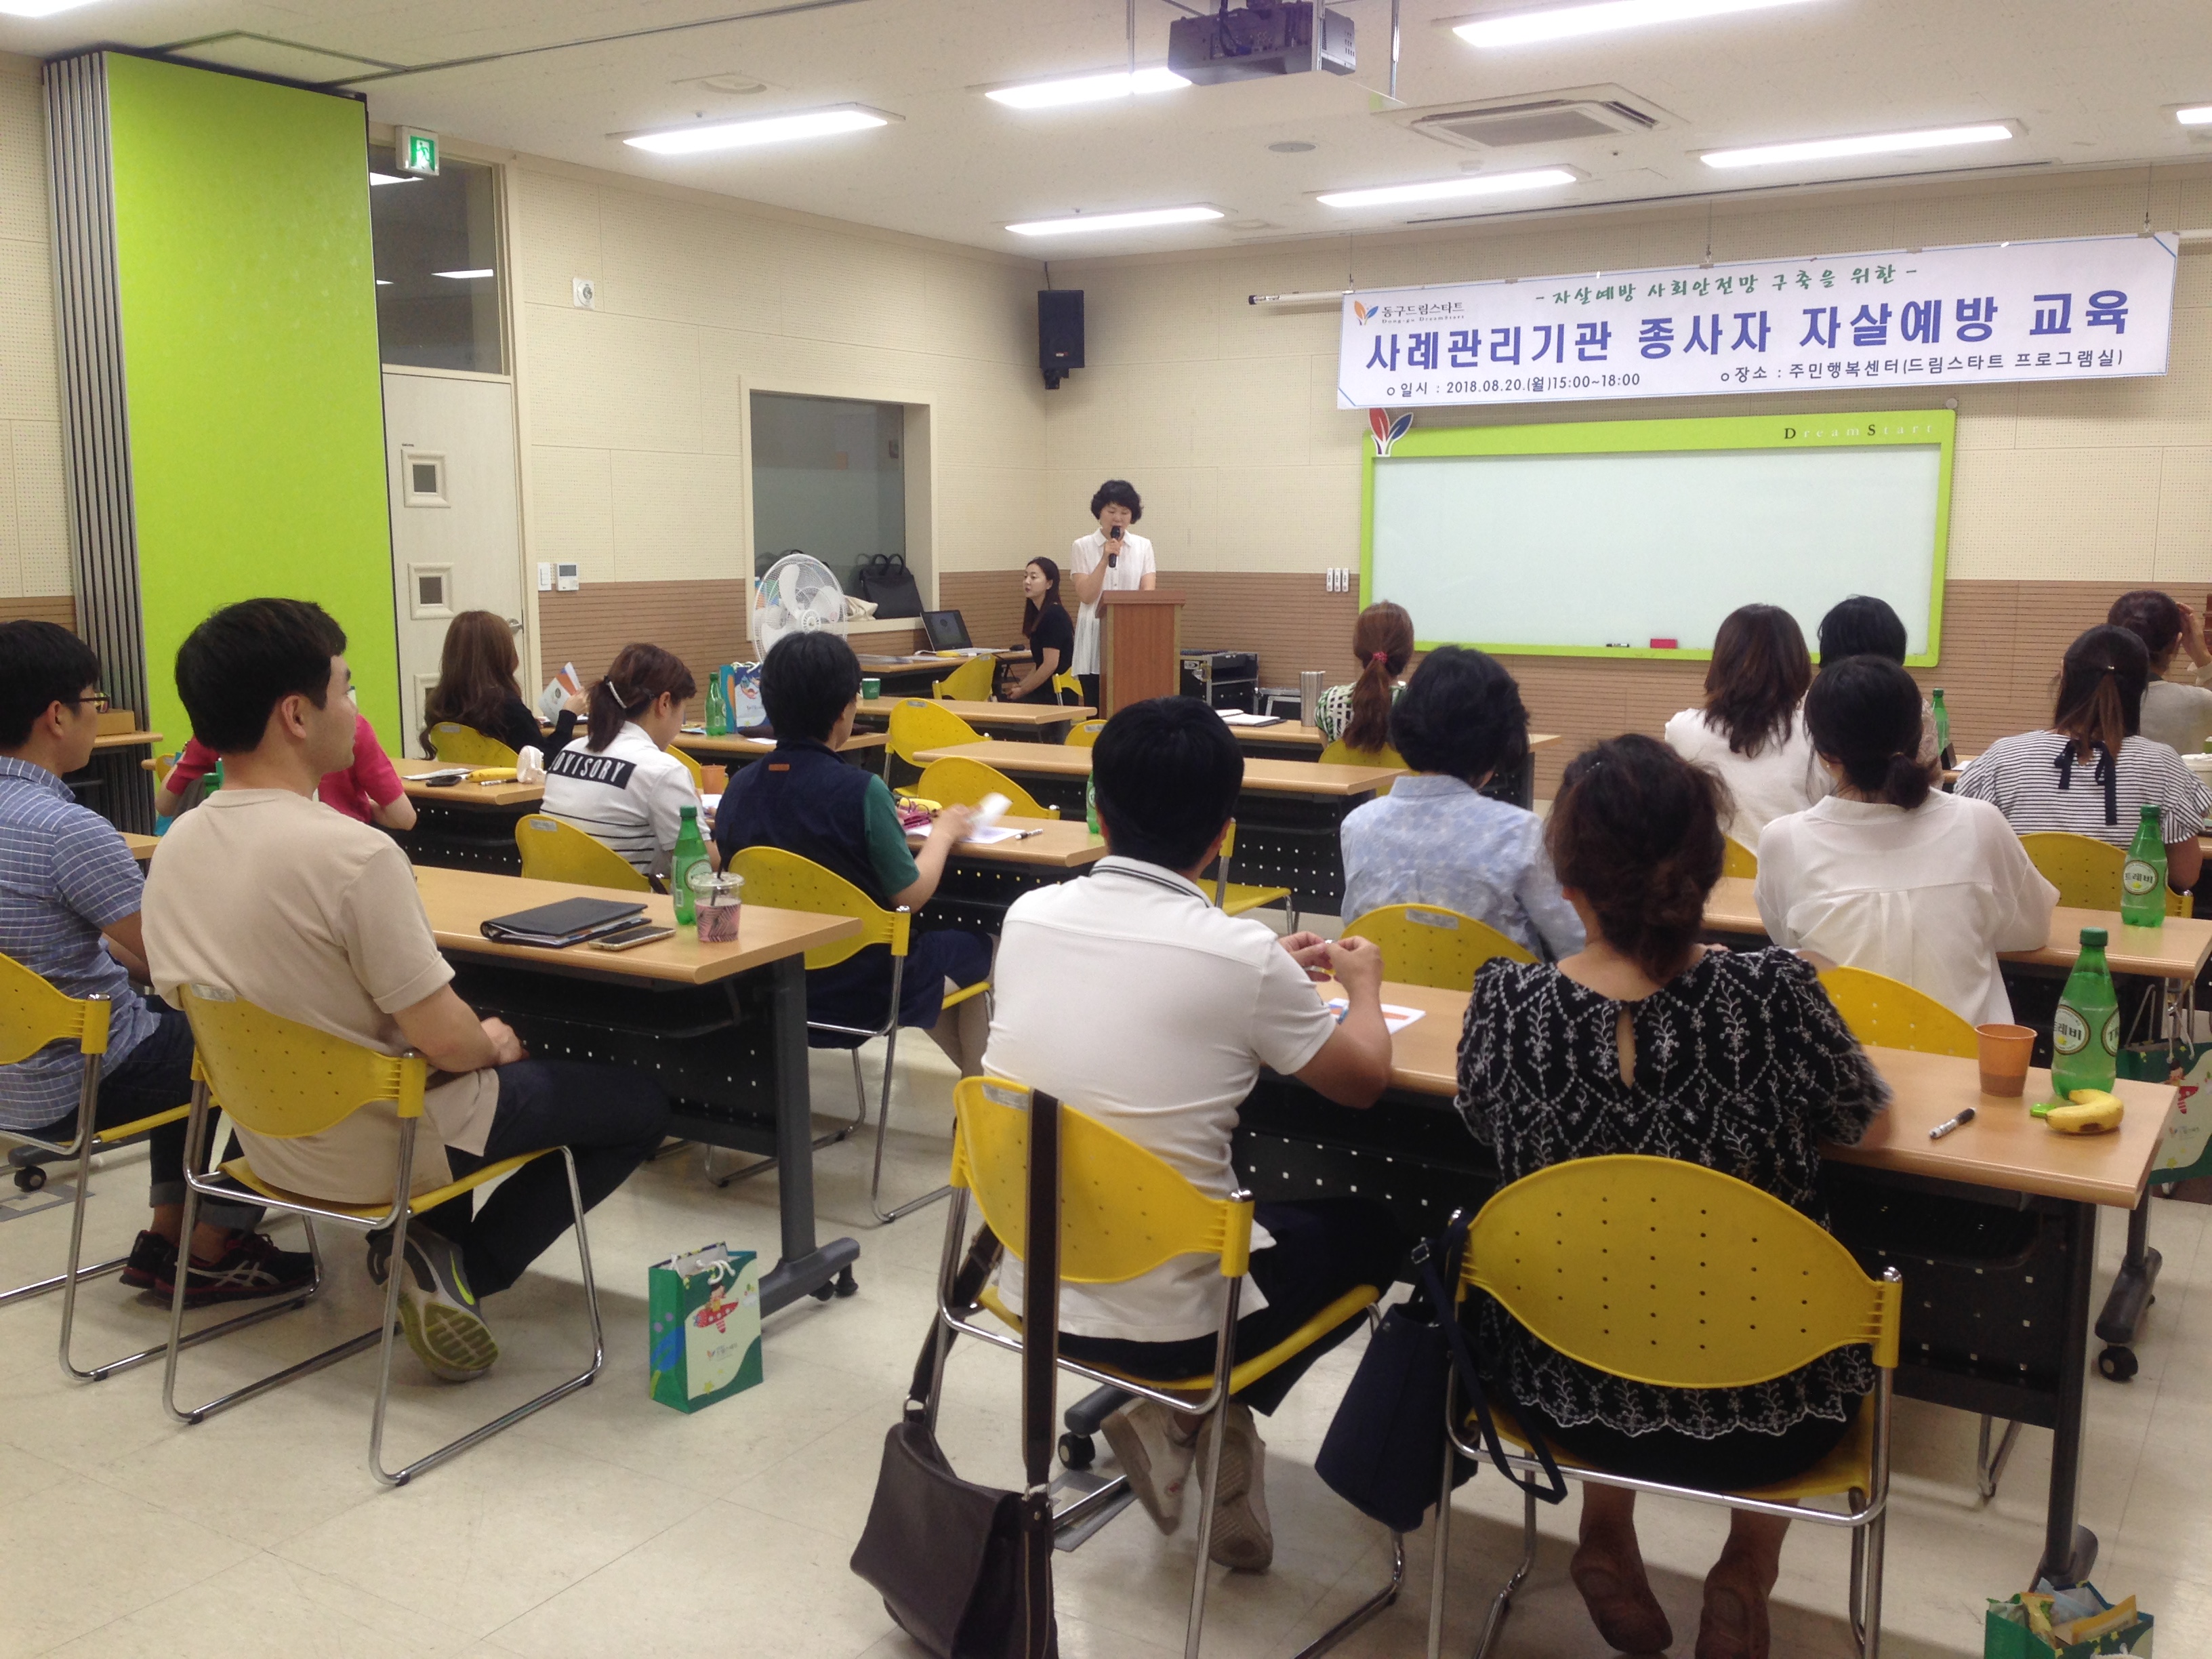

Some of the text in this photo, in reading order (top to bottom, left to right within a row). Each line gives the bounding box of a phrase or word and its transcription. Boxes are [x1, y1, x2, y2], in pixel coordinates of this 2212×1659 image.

[1647, 274, 1759, 297] 사회안전망
[1772, 270, 1835, 291] 구축을
[1381, 302, 1465, 318] 동구드림스타트
[1366, 289, 2129, 371] 사례관리기관 종사자 자살예방 교육
[1788, 353, 2004, 380] 주민행복센터(드림스타트
[2015, 348, 2123, 367] 프로그램실)
[548, 752, 626, 783] DVISORY
